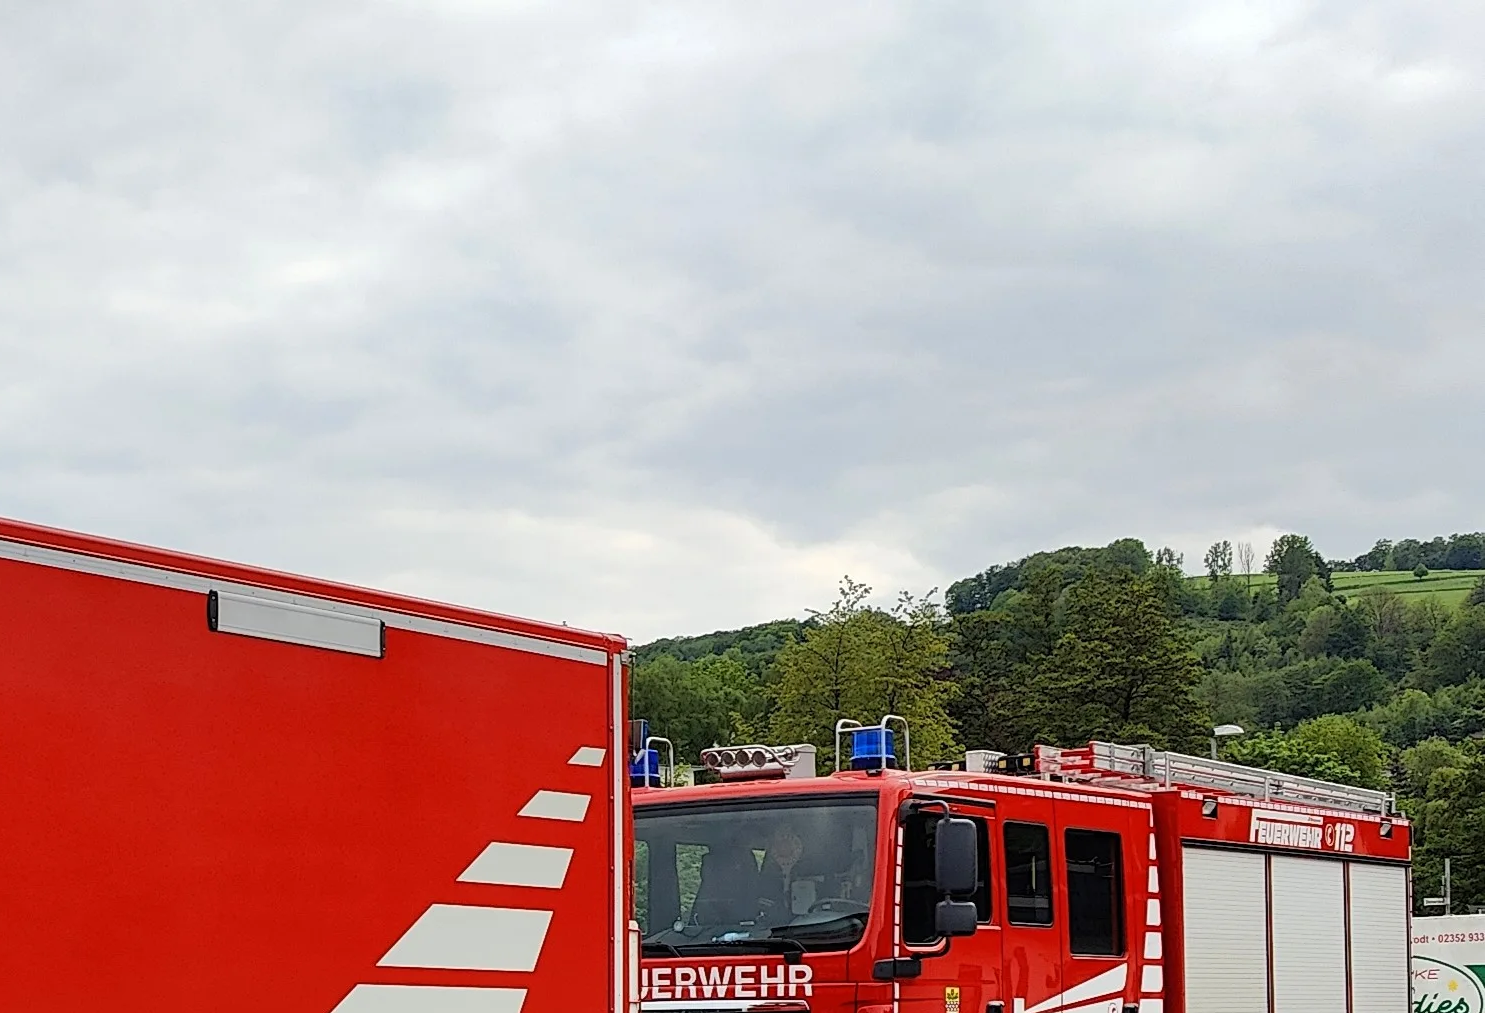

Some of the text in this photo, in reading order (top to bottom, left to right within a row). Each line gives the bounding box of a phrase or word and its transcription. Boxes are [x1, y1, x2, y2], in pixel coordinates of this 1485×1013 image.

[1249, 808, 1355, 853] FEUERWEHR 112
[1413, 933, 1485, 944] odt 02352 933
[1412, 969, 1440, 980] KE
